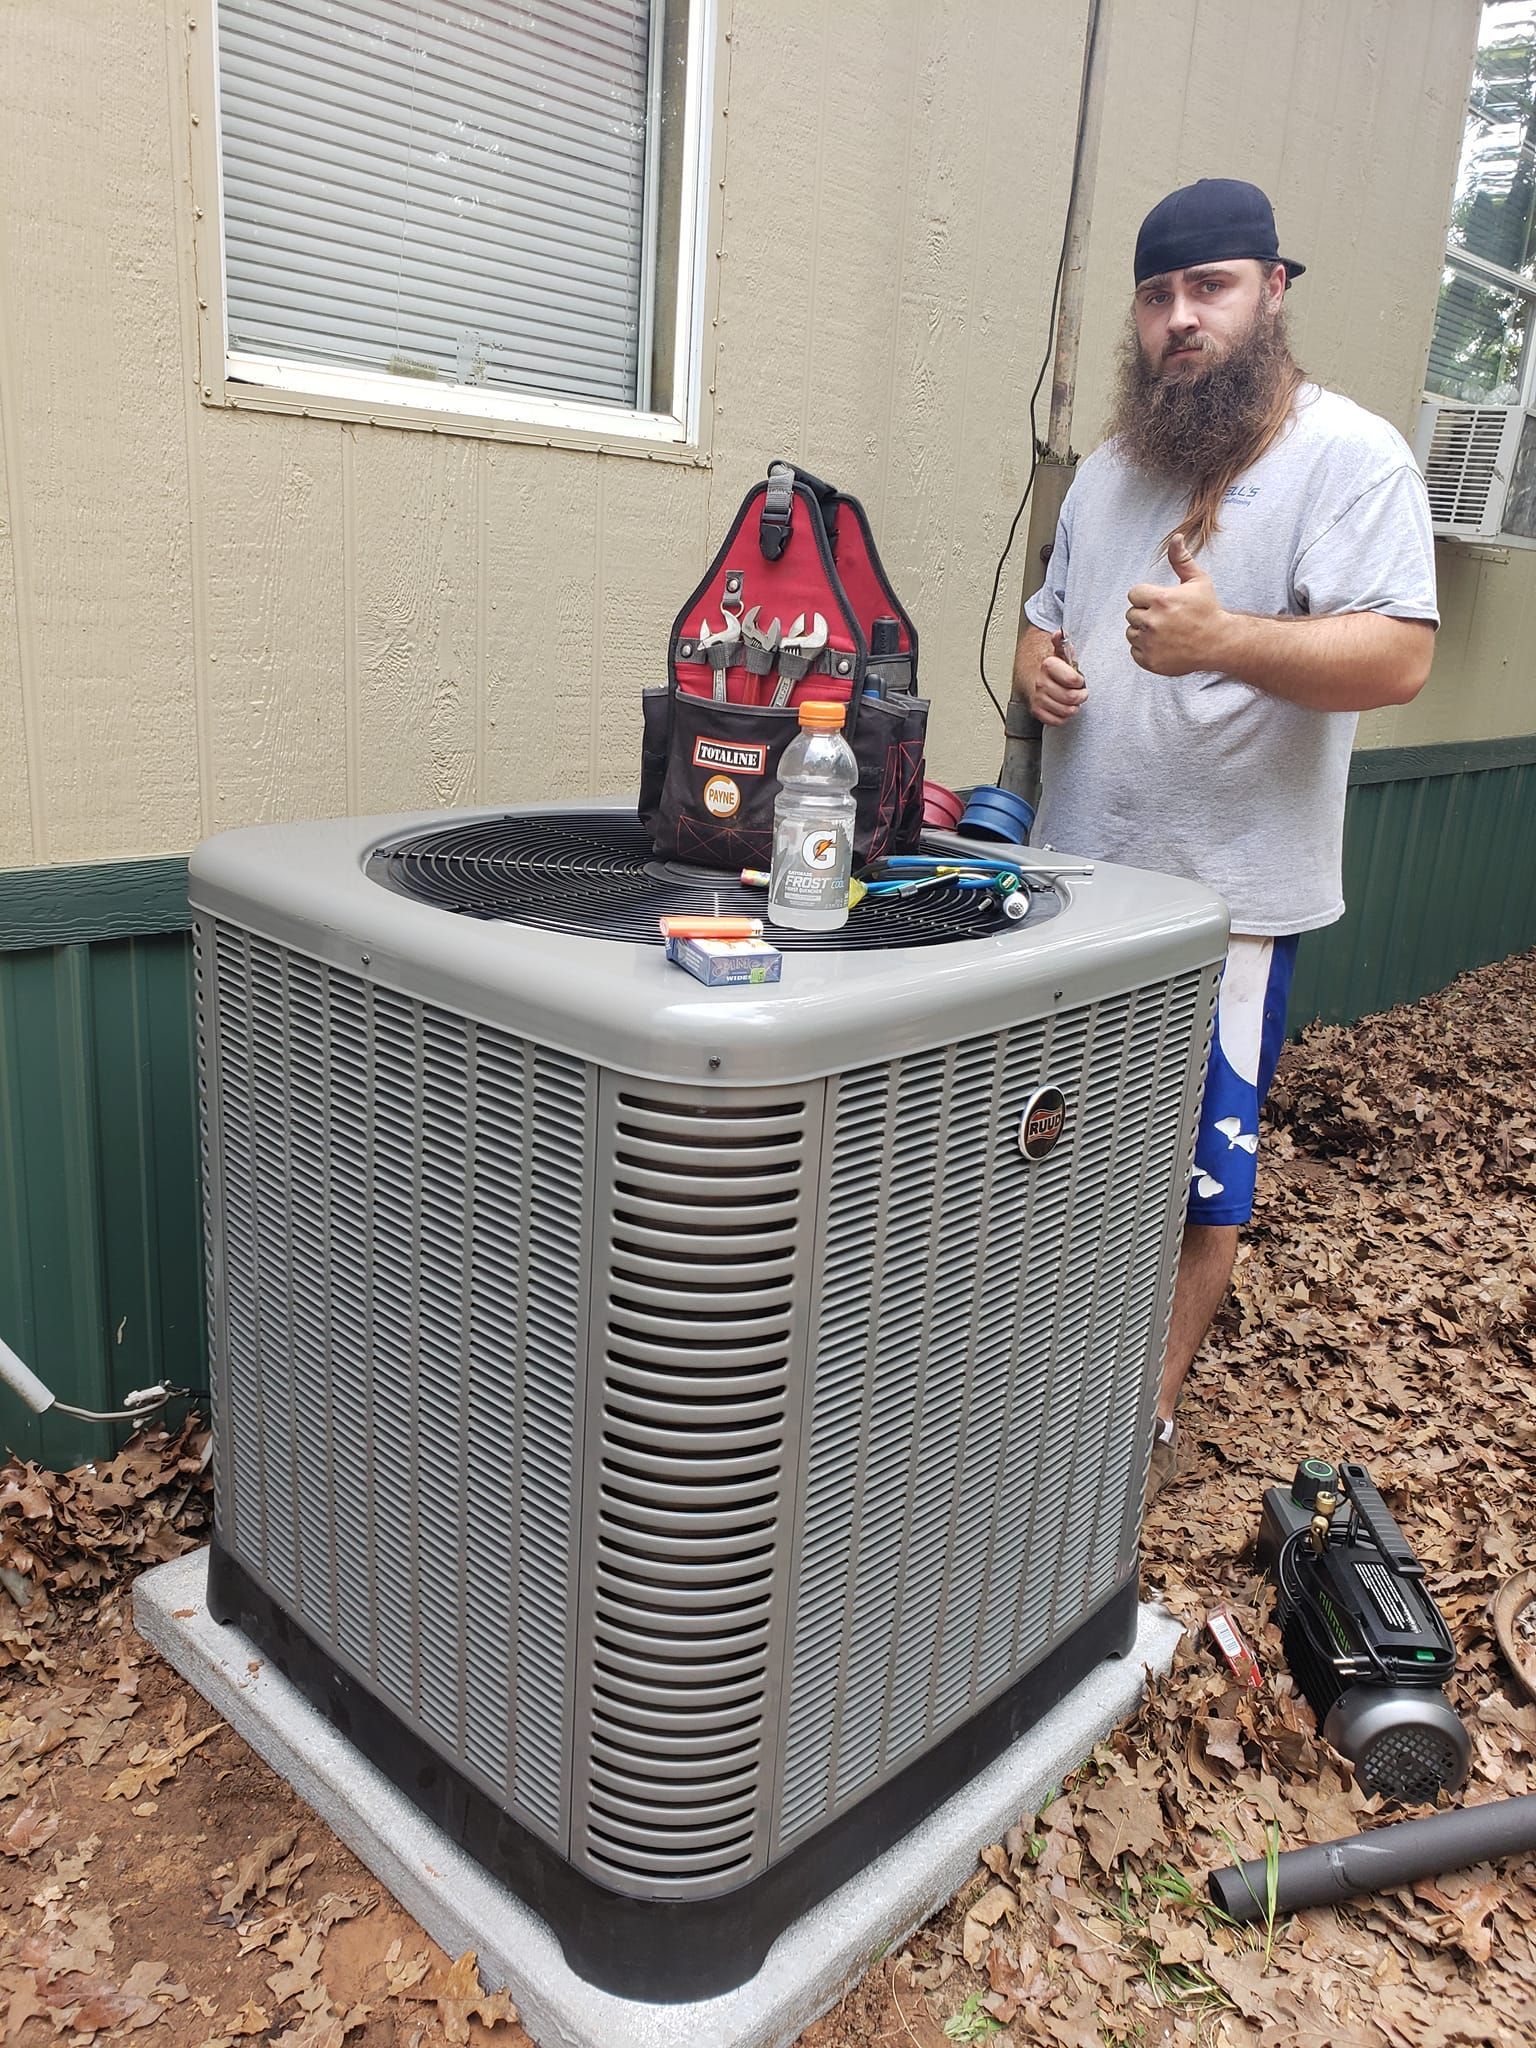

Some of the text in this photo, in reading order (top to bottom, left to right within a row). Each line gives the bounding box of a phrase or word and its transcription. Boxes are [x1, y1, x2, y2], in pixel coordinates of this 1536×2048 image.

[701, 745, 757, 766] TOTALINE
[708, 788, 735, 805] PAYNE
[802, 829, 837, 870] G
[785, 874, 832, 889] FROST
[1029, 1114, 1061, 1136] RUUD
